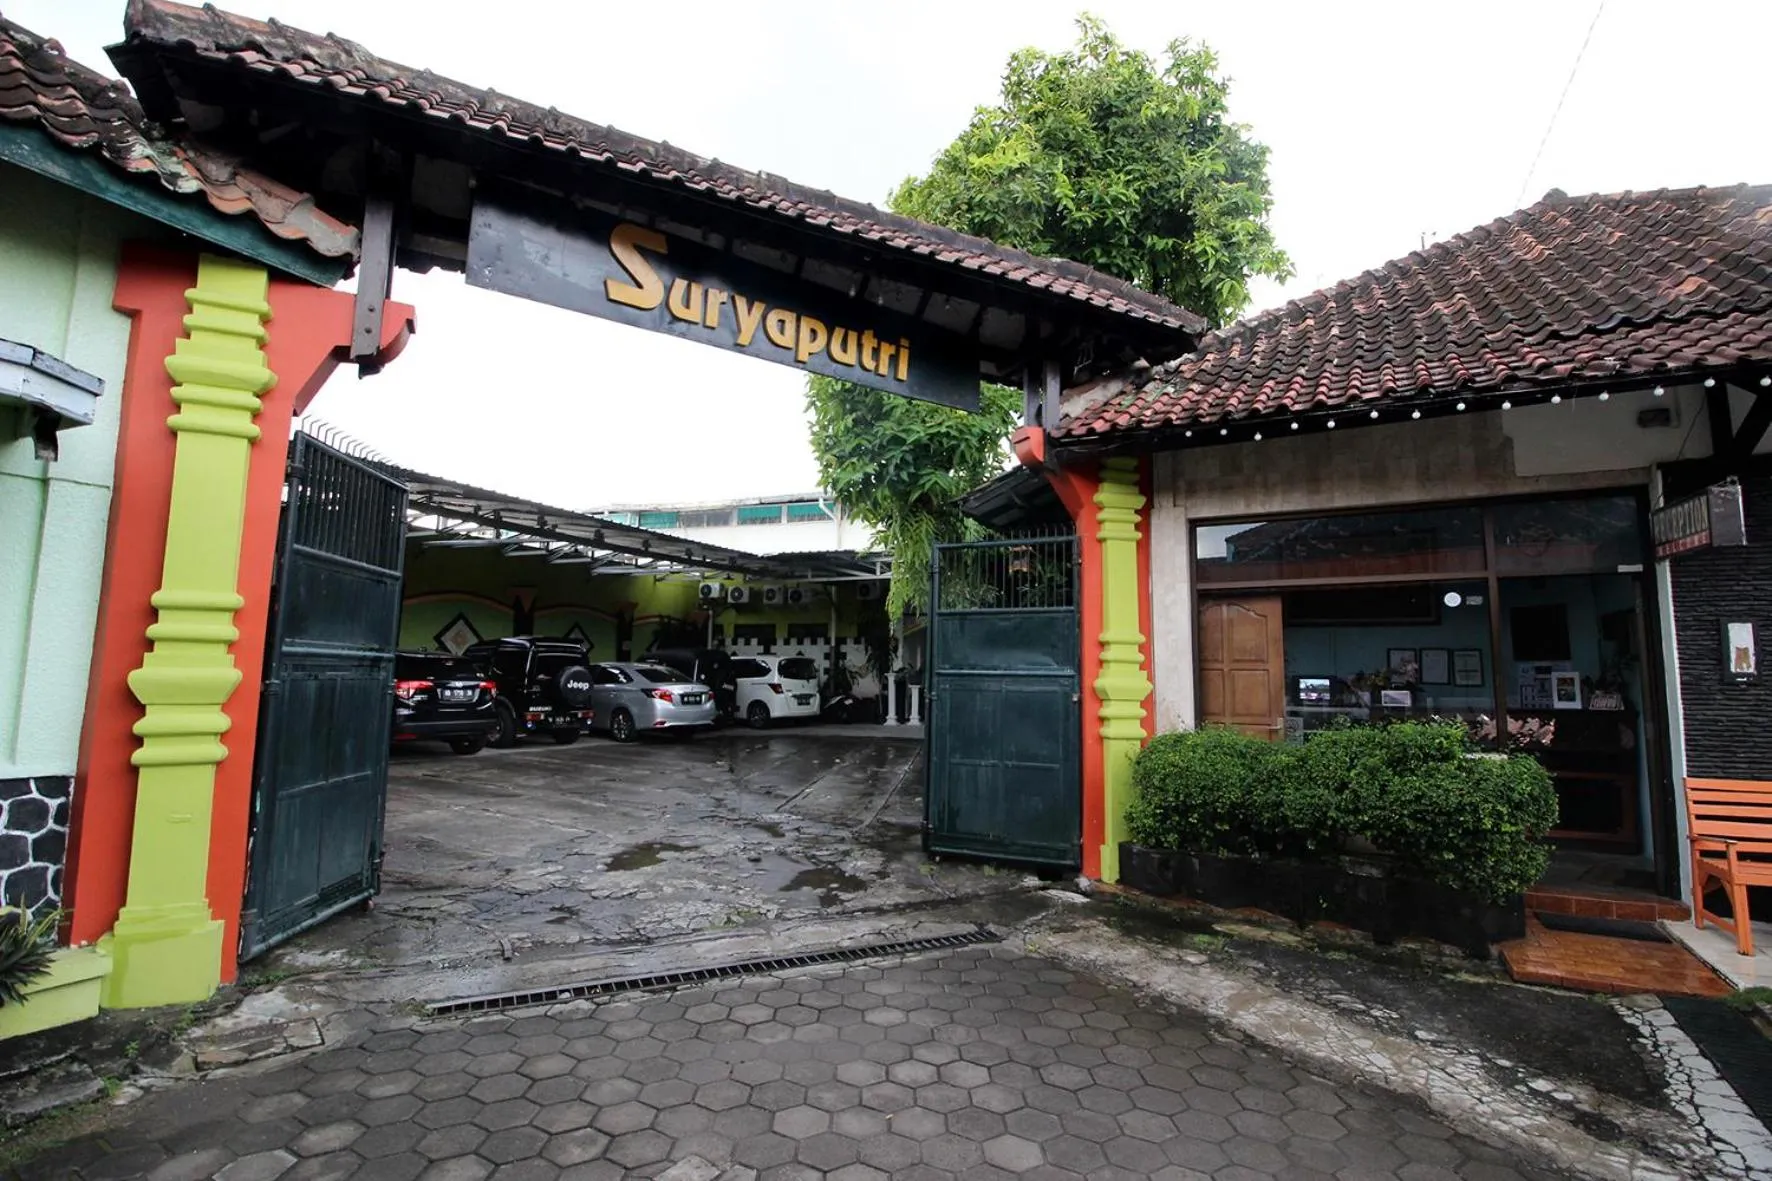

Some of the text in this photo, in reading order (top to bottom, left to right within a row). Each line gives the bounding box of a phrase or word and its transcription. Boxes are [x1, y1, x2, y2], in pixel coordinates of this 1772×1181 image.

[604, 223, 910, 382] Suryaputri
[1652, 495, 1709, 545] RECEPTION
[567, 680, 589, 691] Jeep
